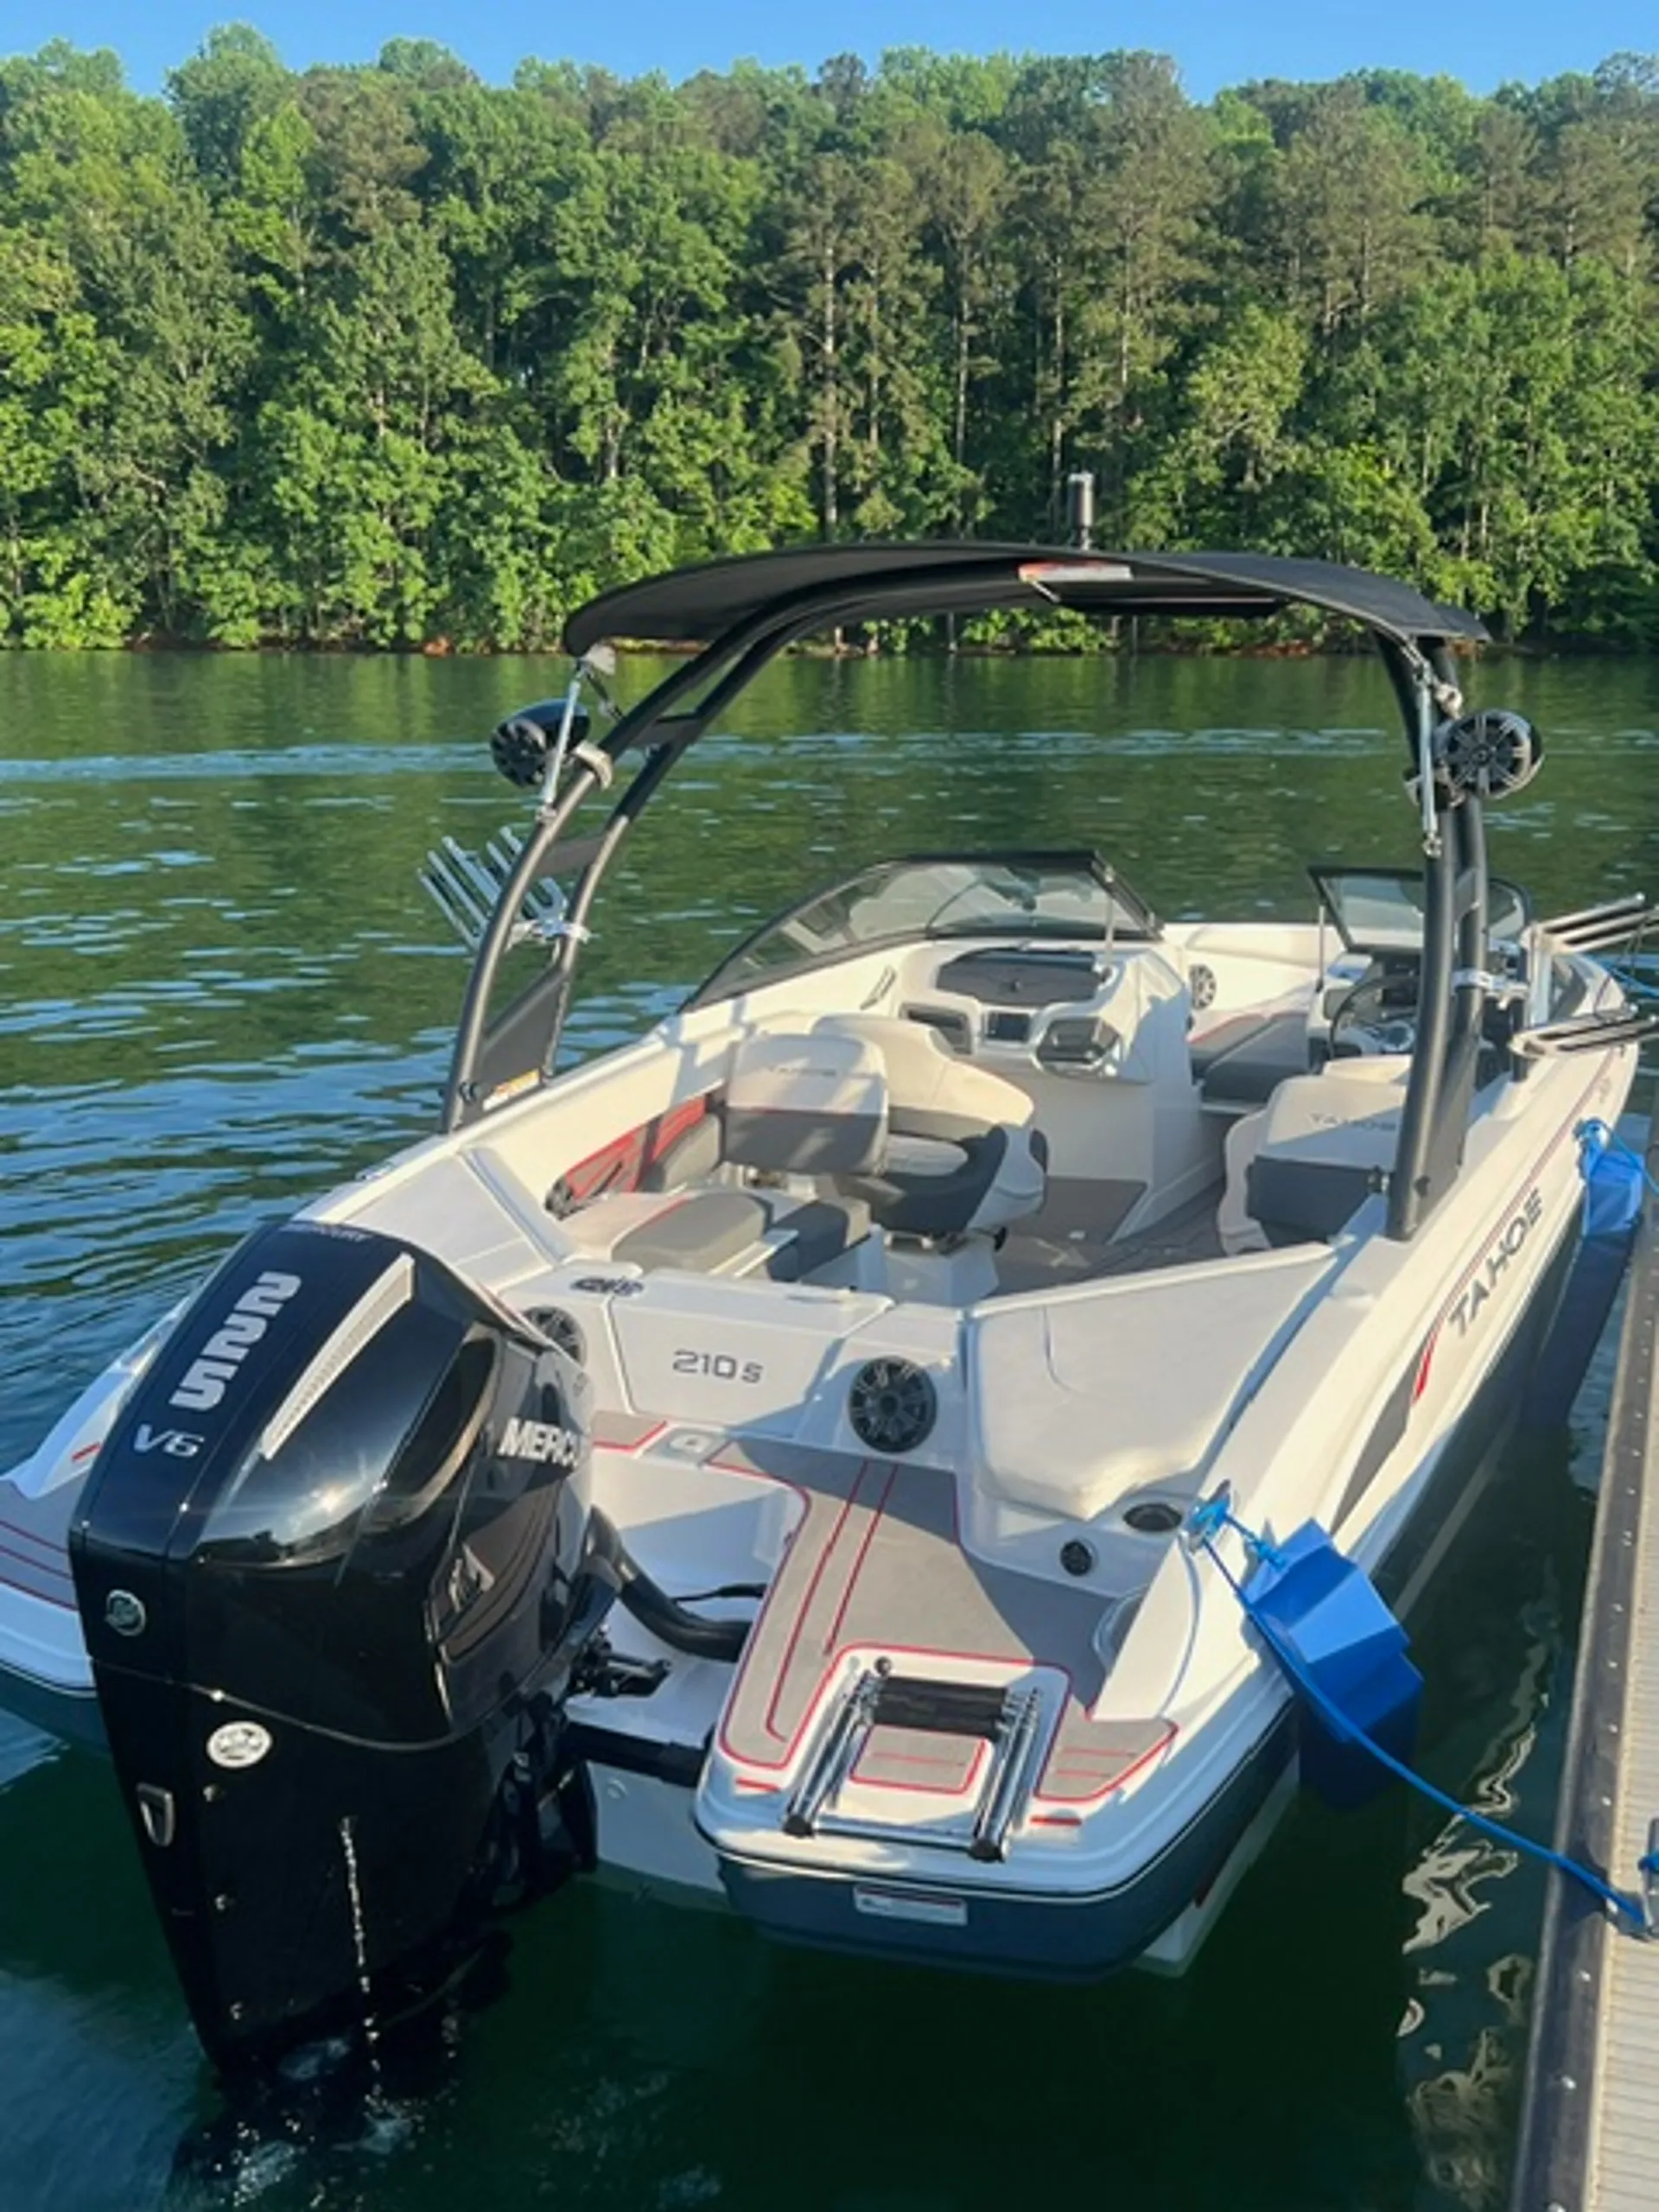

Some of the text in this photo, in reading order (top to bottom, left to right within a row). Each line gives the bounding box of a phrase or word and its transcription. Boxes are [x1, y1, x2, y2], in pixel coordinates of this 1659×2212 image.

[1448, 1188, 1542, 1336] TAHOE
[168, 1271, 302, 1411] 225
[672, 1348, 737, 1381] 210
[134, 1424, 205, 1458] V6
[496, 1416, 579, 1467] MERC
